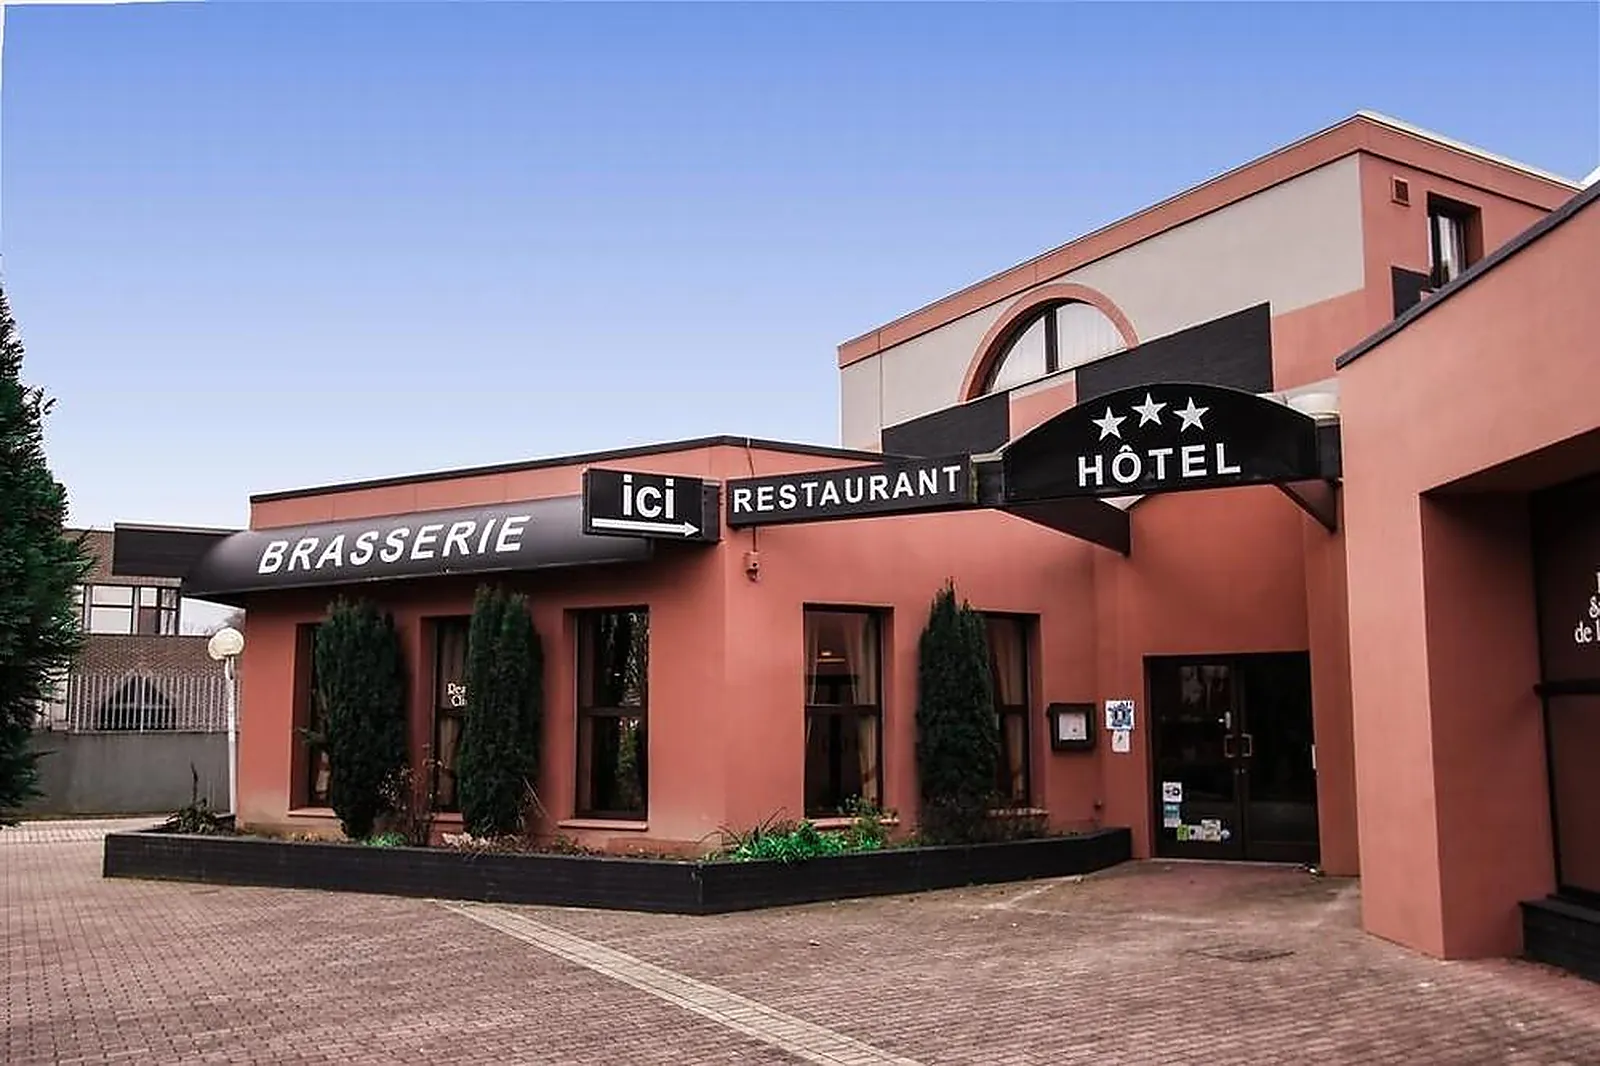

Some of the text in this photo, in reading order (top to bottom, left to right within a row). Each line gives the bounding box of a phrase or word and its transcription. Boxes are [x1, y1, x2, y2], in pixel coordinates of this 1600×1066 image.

[1078, 443, 1241, 487] HÔTEL
[623, 474, 674, 518] ici
[733, 465, 961, 513] RESTAURANT
[258, 515, 533, 574] BRASSERIE
[1574, 621, 1593, 643] de
